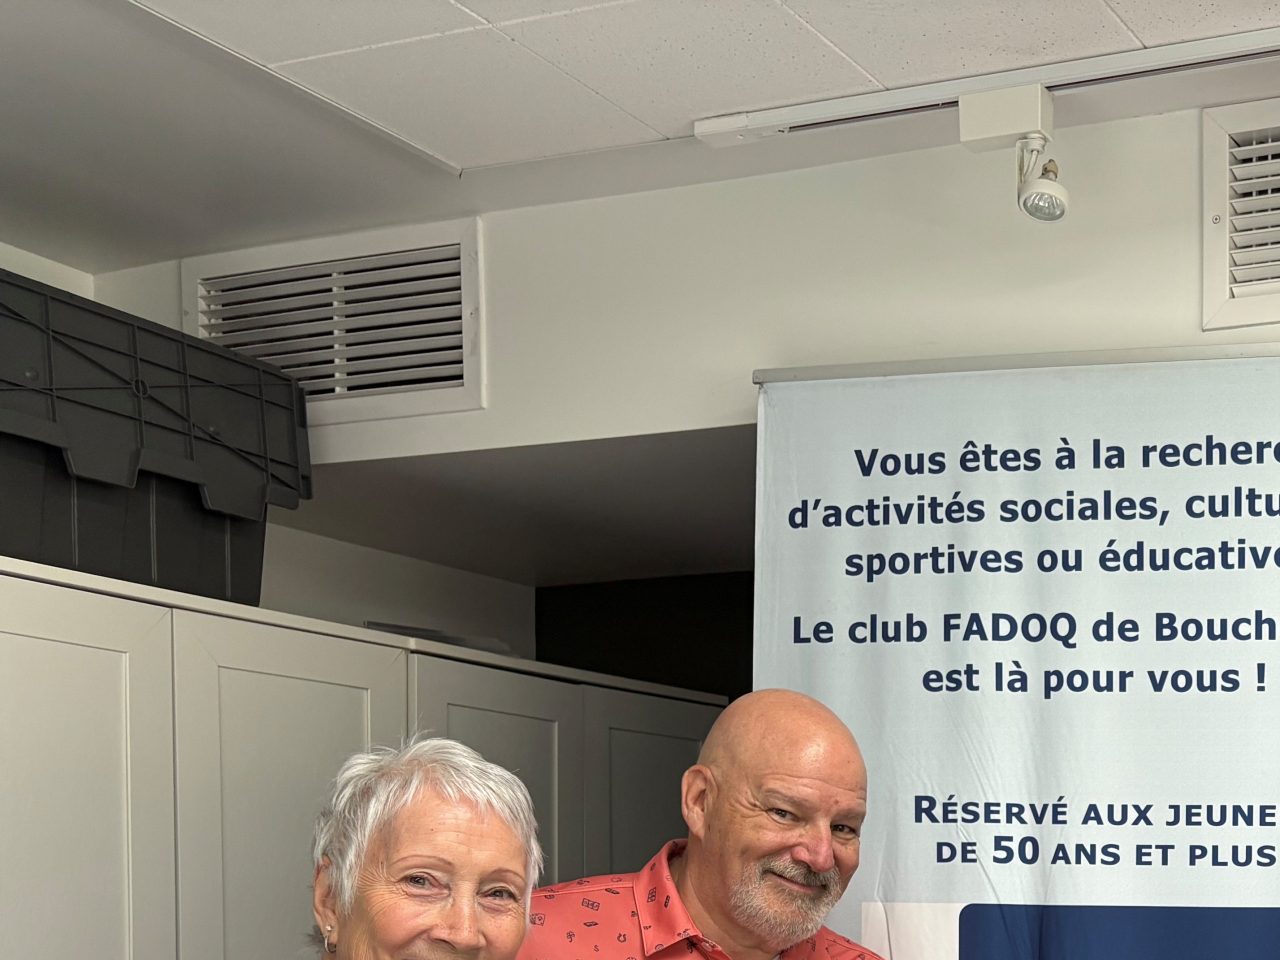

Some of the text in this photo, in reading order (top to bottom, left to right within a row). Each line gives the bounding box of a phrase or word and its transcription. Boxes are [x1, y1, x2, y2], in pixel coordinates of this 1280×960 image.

[853, 448, 946, 477] Vous
[959, 440, 1042, 473] êtes
[1055, 437, 1076, 471] à
[1092, 438, 1125, 469] la
[788, 490, 985, 529] d’activités
[999, 489, 1170, 526] sociales,
[845, 543, 1024, 583] sportives
[1036, 549, 1082, 573] ou
[793, 616, 834, 644] Le
[848, 613, 928, 644] club
[943, 612, 1077, 649] FADOQ
[1092, 611, 1140, 643] de
[922, 660, 1266, 700] est là pour vous !
[914, 795, 1068, 825] RÉSERVÉ
[1081, 803, 1154, 826] AUX
[936, 835, 1277, 867] DE 50 ANS ET PLUS
